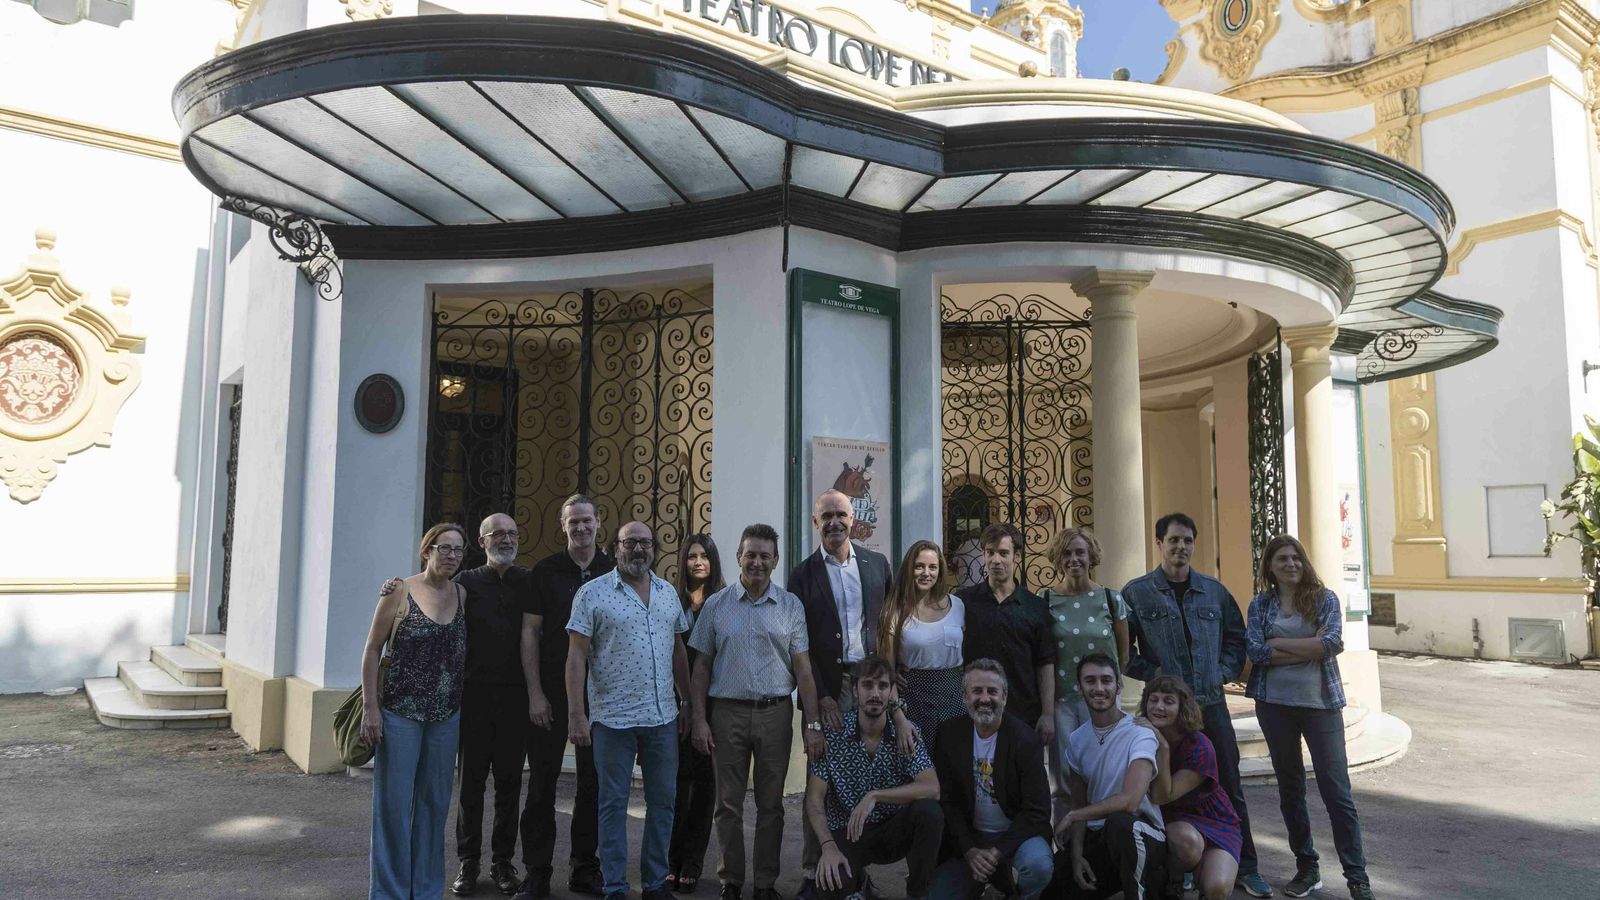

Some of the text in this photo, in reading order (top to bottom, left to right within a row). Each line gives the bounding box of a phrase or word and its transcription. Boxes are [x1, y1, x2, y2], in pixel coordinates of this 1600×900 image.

[828, 28, 903, 87] LOPE
[821, 298, 842, 307] TEATRO
[843, 302, 857, 310] LOPE
